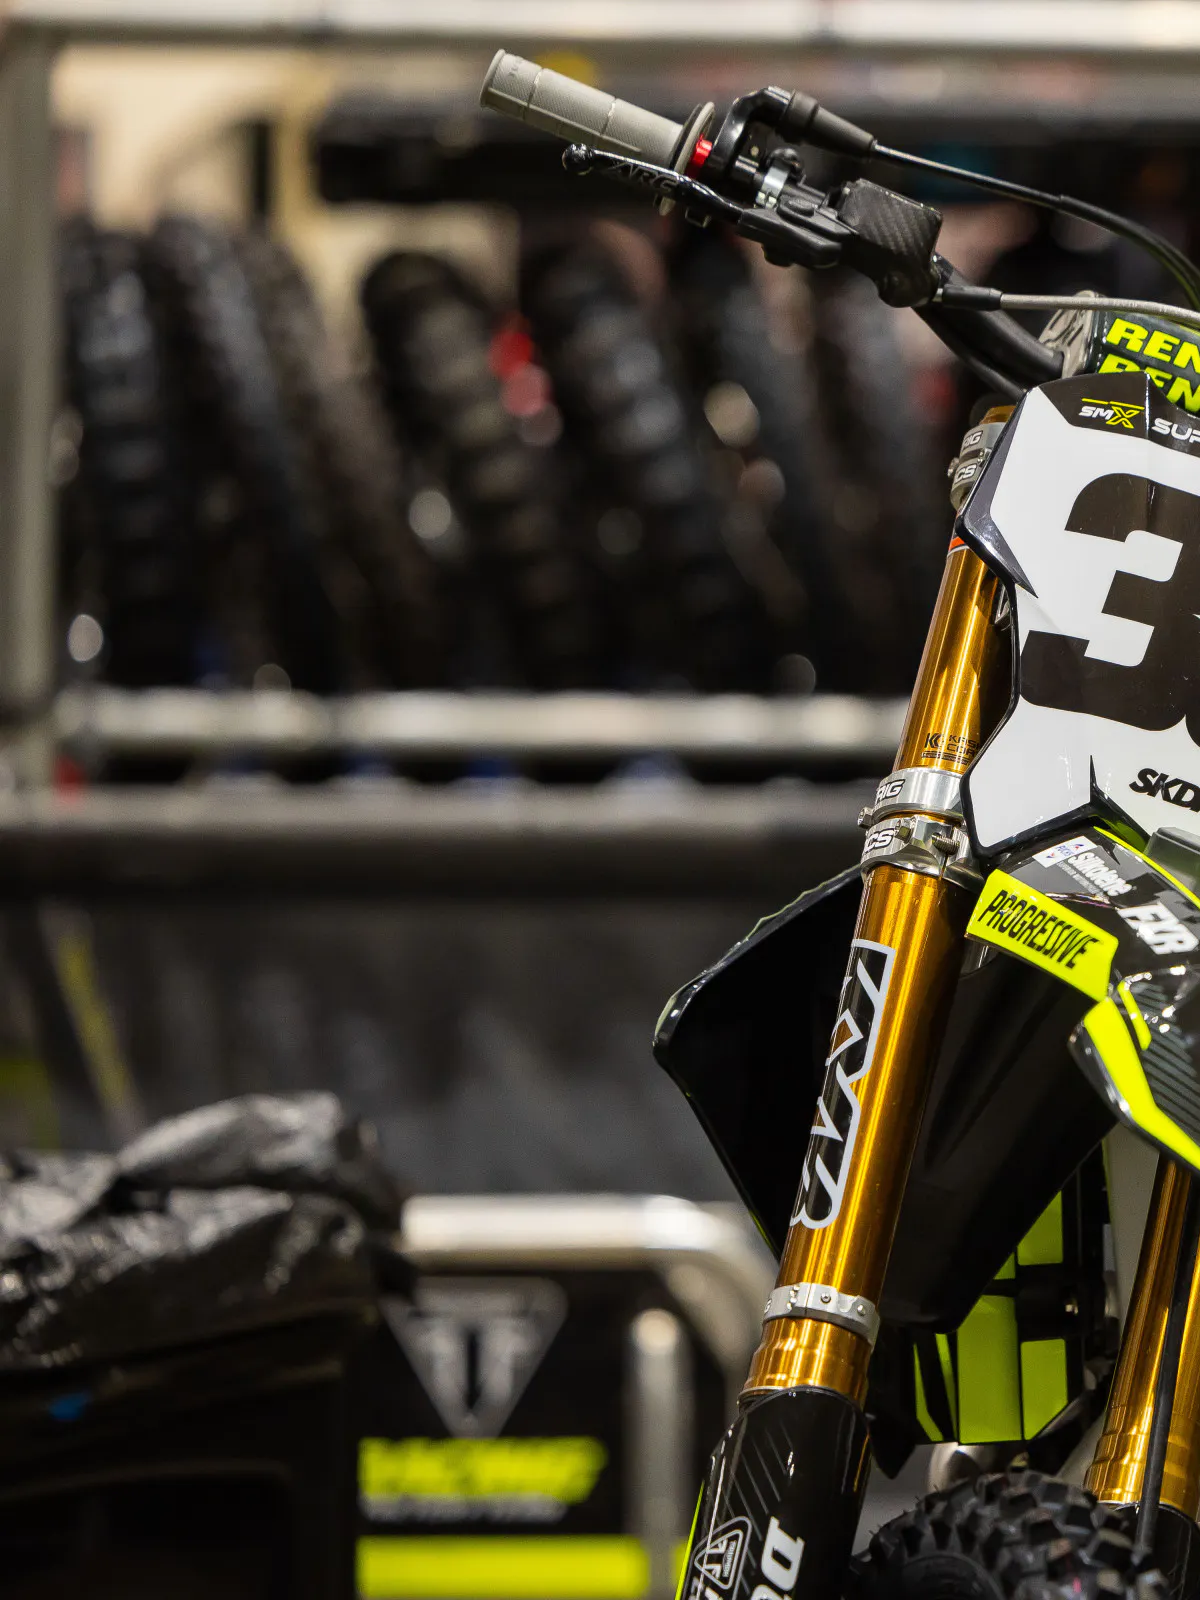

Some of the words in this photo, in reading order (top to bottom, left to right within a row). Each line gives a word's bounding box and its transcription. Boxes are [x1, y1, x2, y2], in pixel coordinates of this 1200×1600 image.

[1079, 403, 1139, 429] SMX
[978, 889, 1099, 969] PROGRESSIVE
[1116, 900, 1199, 955] FXR
